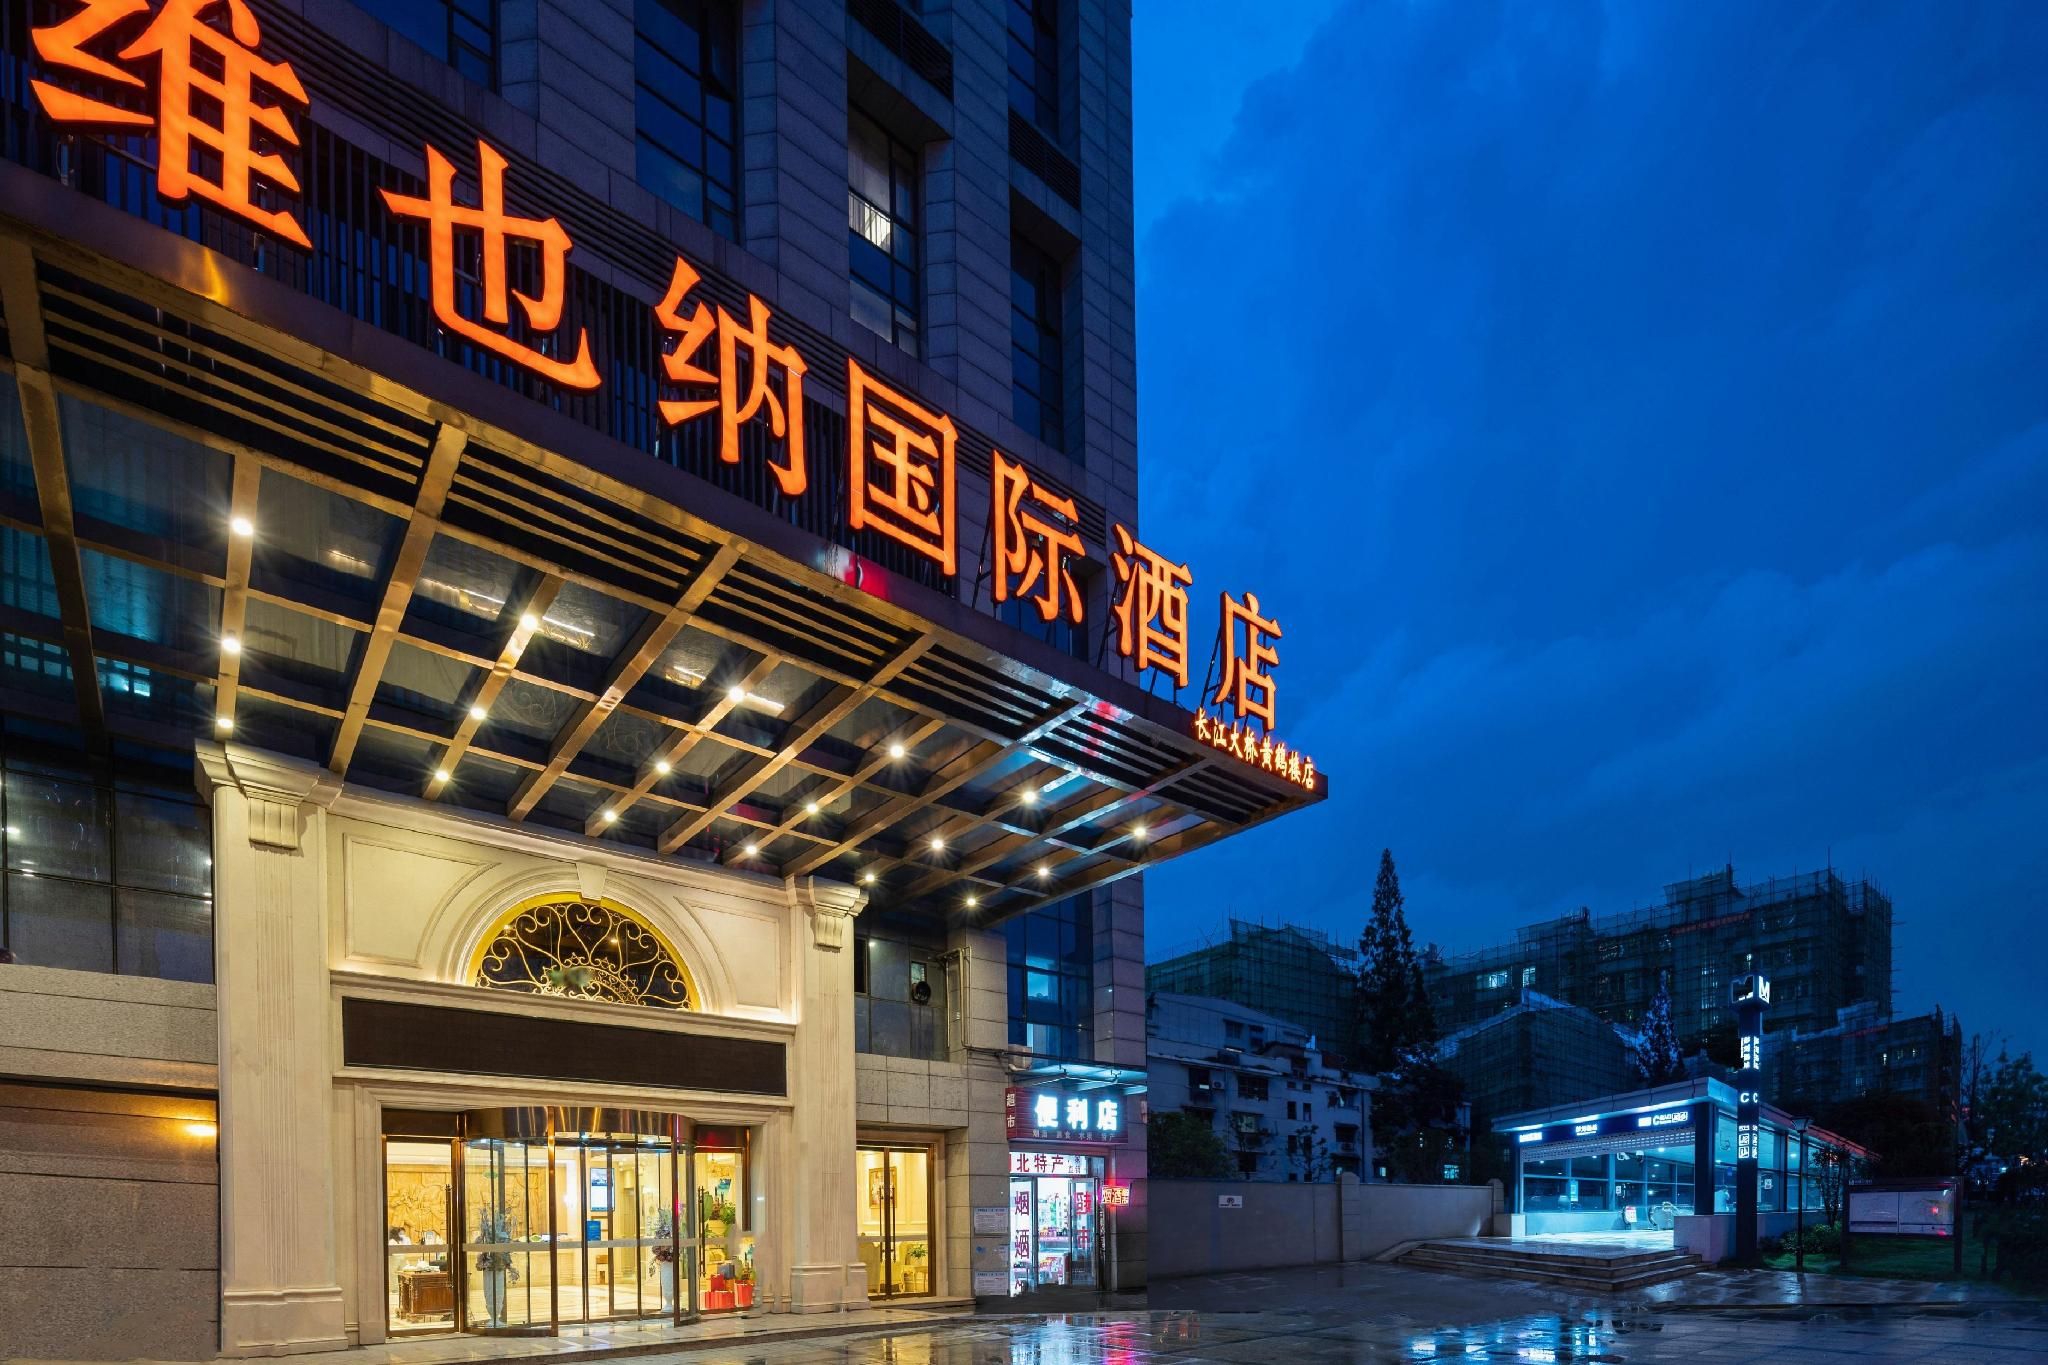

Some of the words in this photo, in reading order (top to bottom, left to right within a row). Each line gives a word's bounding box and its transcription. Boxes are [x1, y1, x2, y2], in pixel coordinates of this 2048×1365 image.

[30, 0, 1283, 733] 维也纳国际酒店
[1034, 1094, 1118, 1131] 便利店
[1008, 1153, 1064, 1174] 北特产
